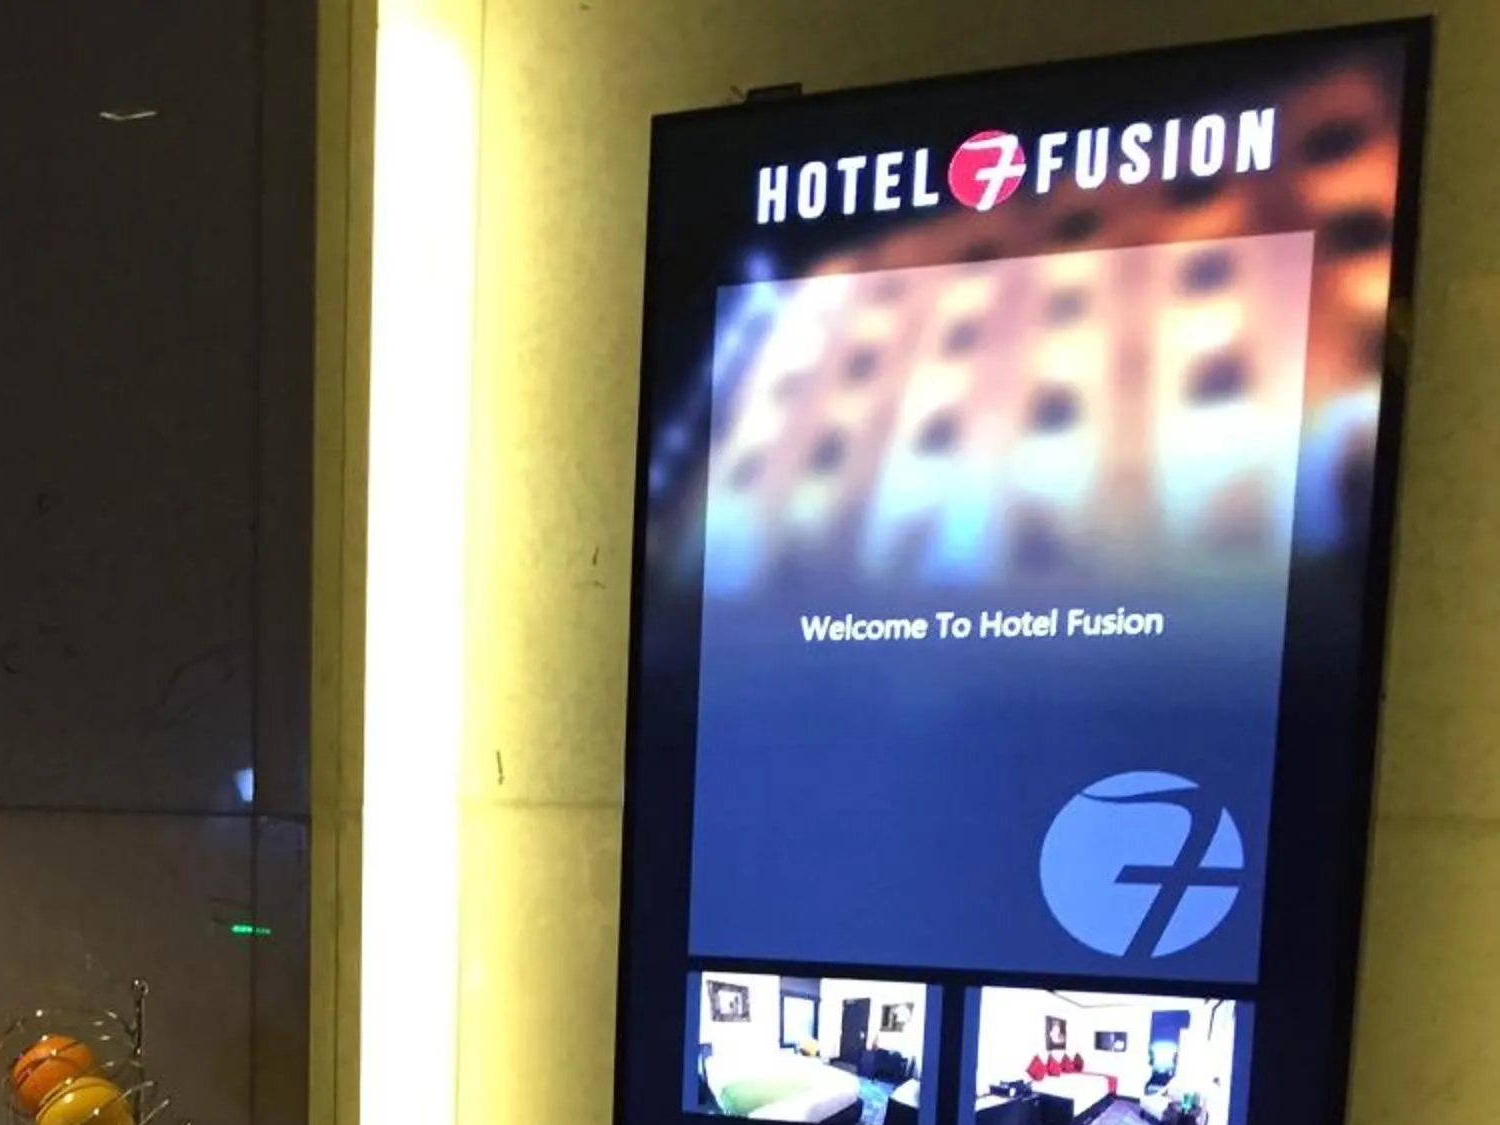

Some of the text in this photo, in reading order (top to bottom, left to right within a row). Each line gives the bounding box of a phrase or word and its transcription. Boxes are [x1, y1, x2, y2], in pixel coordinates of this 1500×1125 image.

[757, 148, 940, 225] HOTEL
[1036, 107, 1276, 195] FUSION
[800, 606, 1164, 642] Welcome To Hotel Fusion
